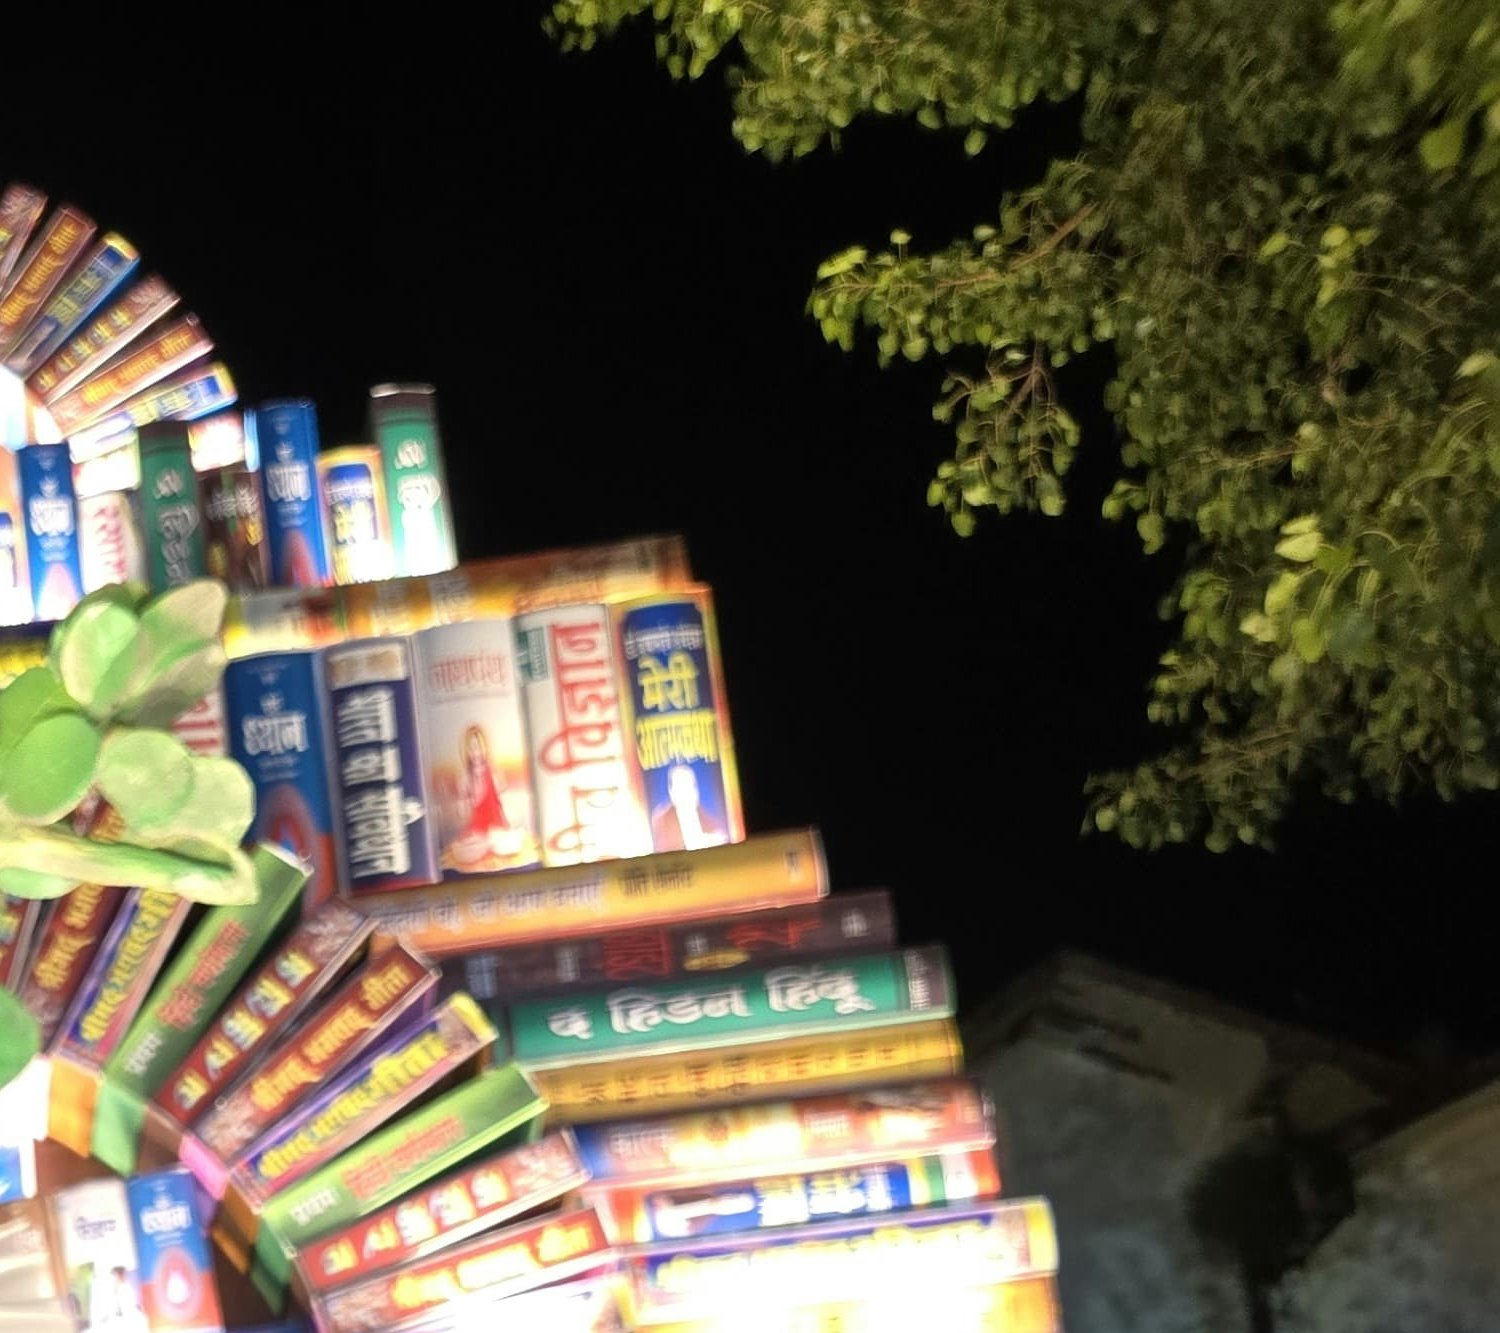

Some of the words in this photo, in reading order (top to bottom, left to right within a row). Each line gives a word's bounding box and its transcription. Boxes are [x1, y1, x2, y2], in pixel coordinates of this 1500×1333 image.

[539, 621, 619, 774] विज्ञान
[638, 651, 699, 712] मेरी
[337, 686, 398, 747] भारत
[635, 711, 719, 771] आत्मकथा
[342, 745, 401, 787] का
[345, 786, 425, 878] संविधान
[547, 1008, 594, 1040] द
[605, 987, 753, 1034] हिडन
[764, 963, 876, 1015] हिंदू
